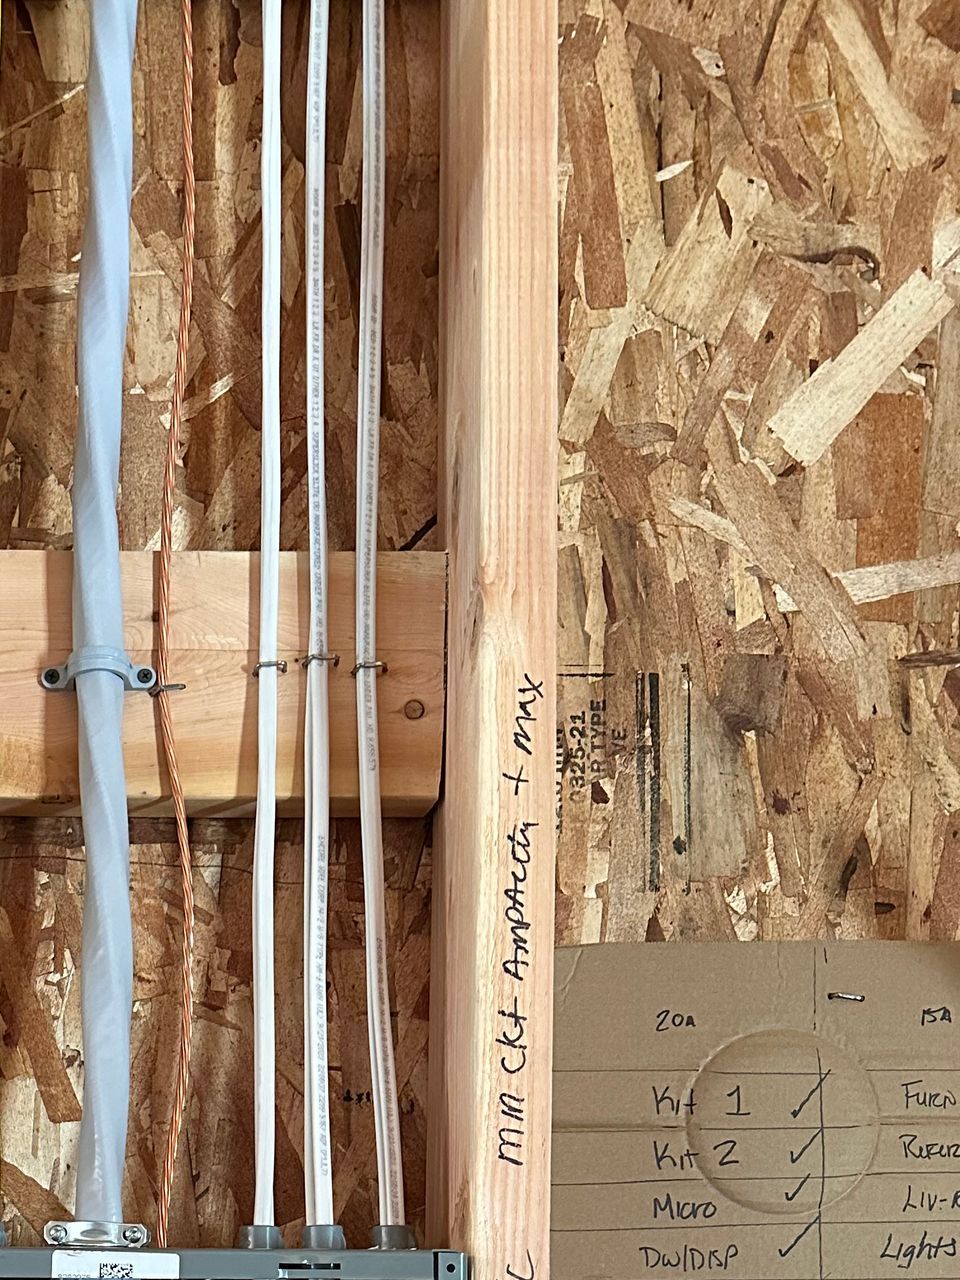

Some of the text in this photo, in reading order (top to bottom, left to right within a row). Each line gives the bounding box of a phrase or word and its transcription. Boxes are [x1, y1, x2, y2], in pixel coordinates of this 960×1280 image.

[652, 1085, 751, 1116] Kit 1
[653, 1139, 740, 1171] Kit 2
